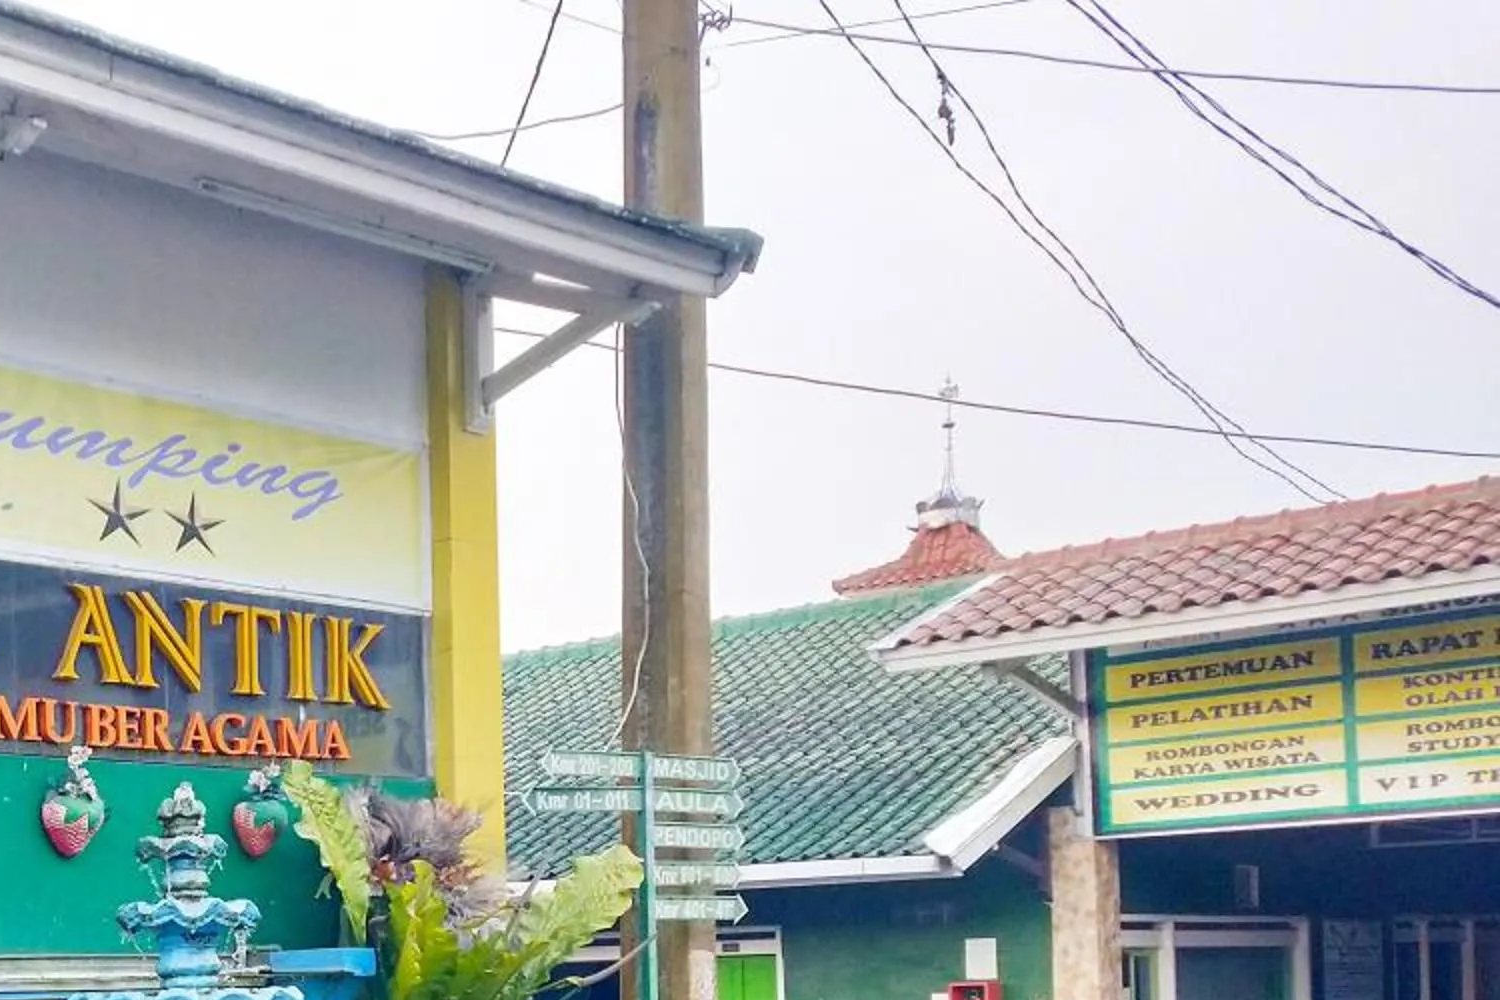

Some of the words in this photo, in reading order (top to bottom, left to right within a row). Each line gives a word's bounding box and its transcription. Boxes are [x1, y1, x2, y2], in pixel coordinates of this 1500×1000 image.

[53, 582, 392, 710] ANTIK
[1371, 630, 1483, 658] RAPAT
[1130, 651, 1314, 688] PERTEMUAN
[1405, 688, 1484, 707] OLAH
[1130, 695, 1313, 730] PELATIHAN
[182, 711, 351, 762] AGAMA
[1146, 735, 1305, 762] ROMBONGAN
[655, 759, 730, 780] MASJID
[1133, 761, 1216, 779] KARYA
[1222, 751, 1321, 770] WISATA
[656, 792, 730, 808] AULA
[1134, 783, 1322, 811] WEDDING
